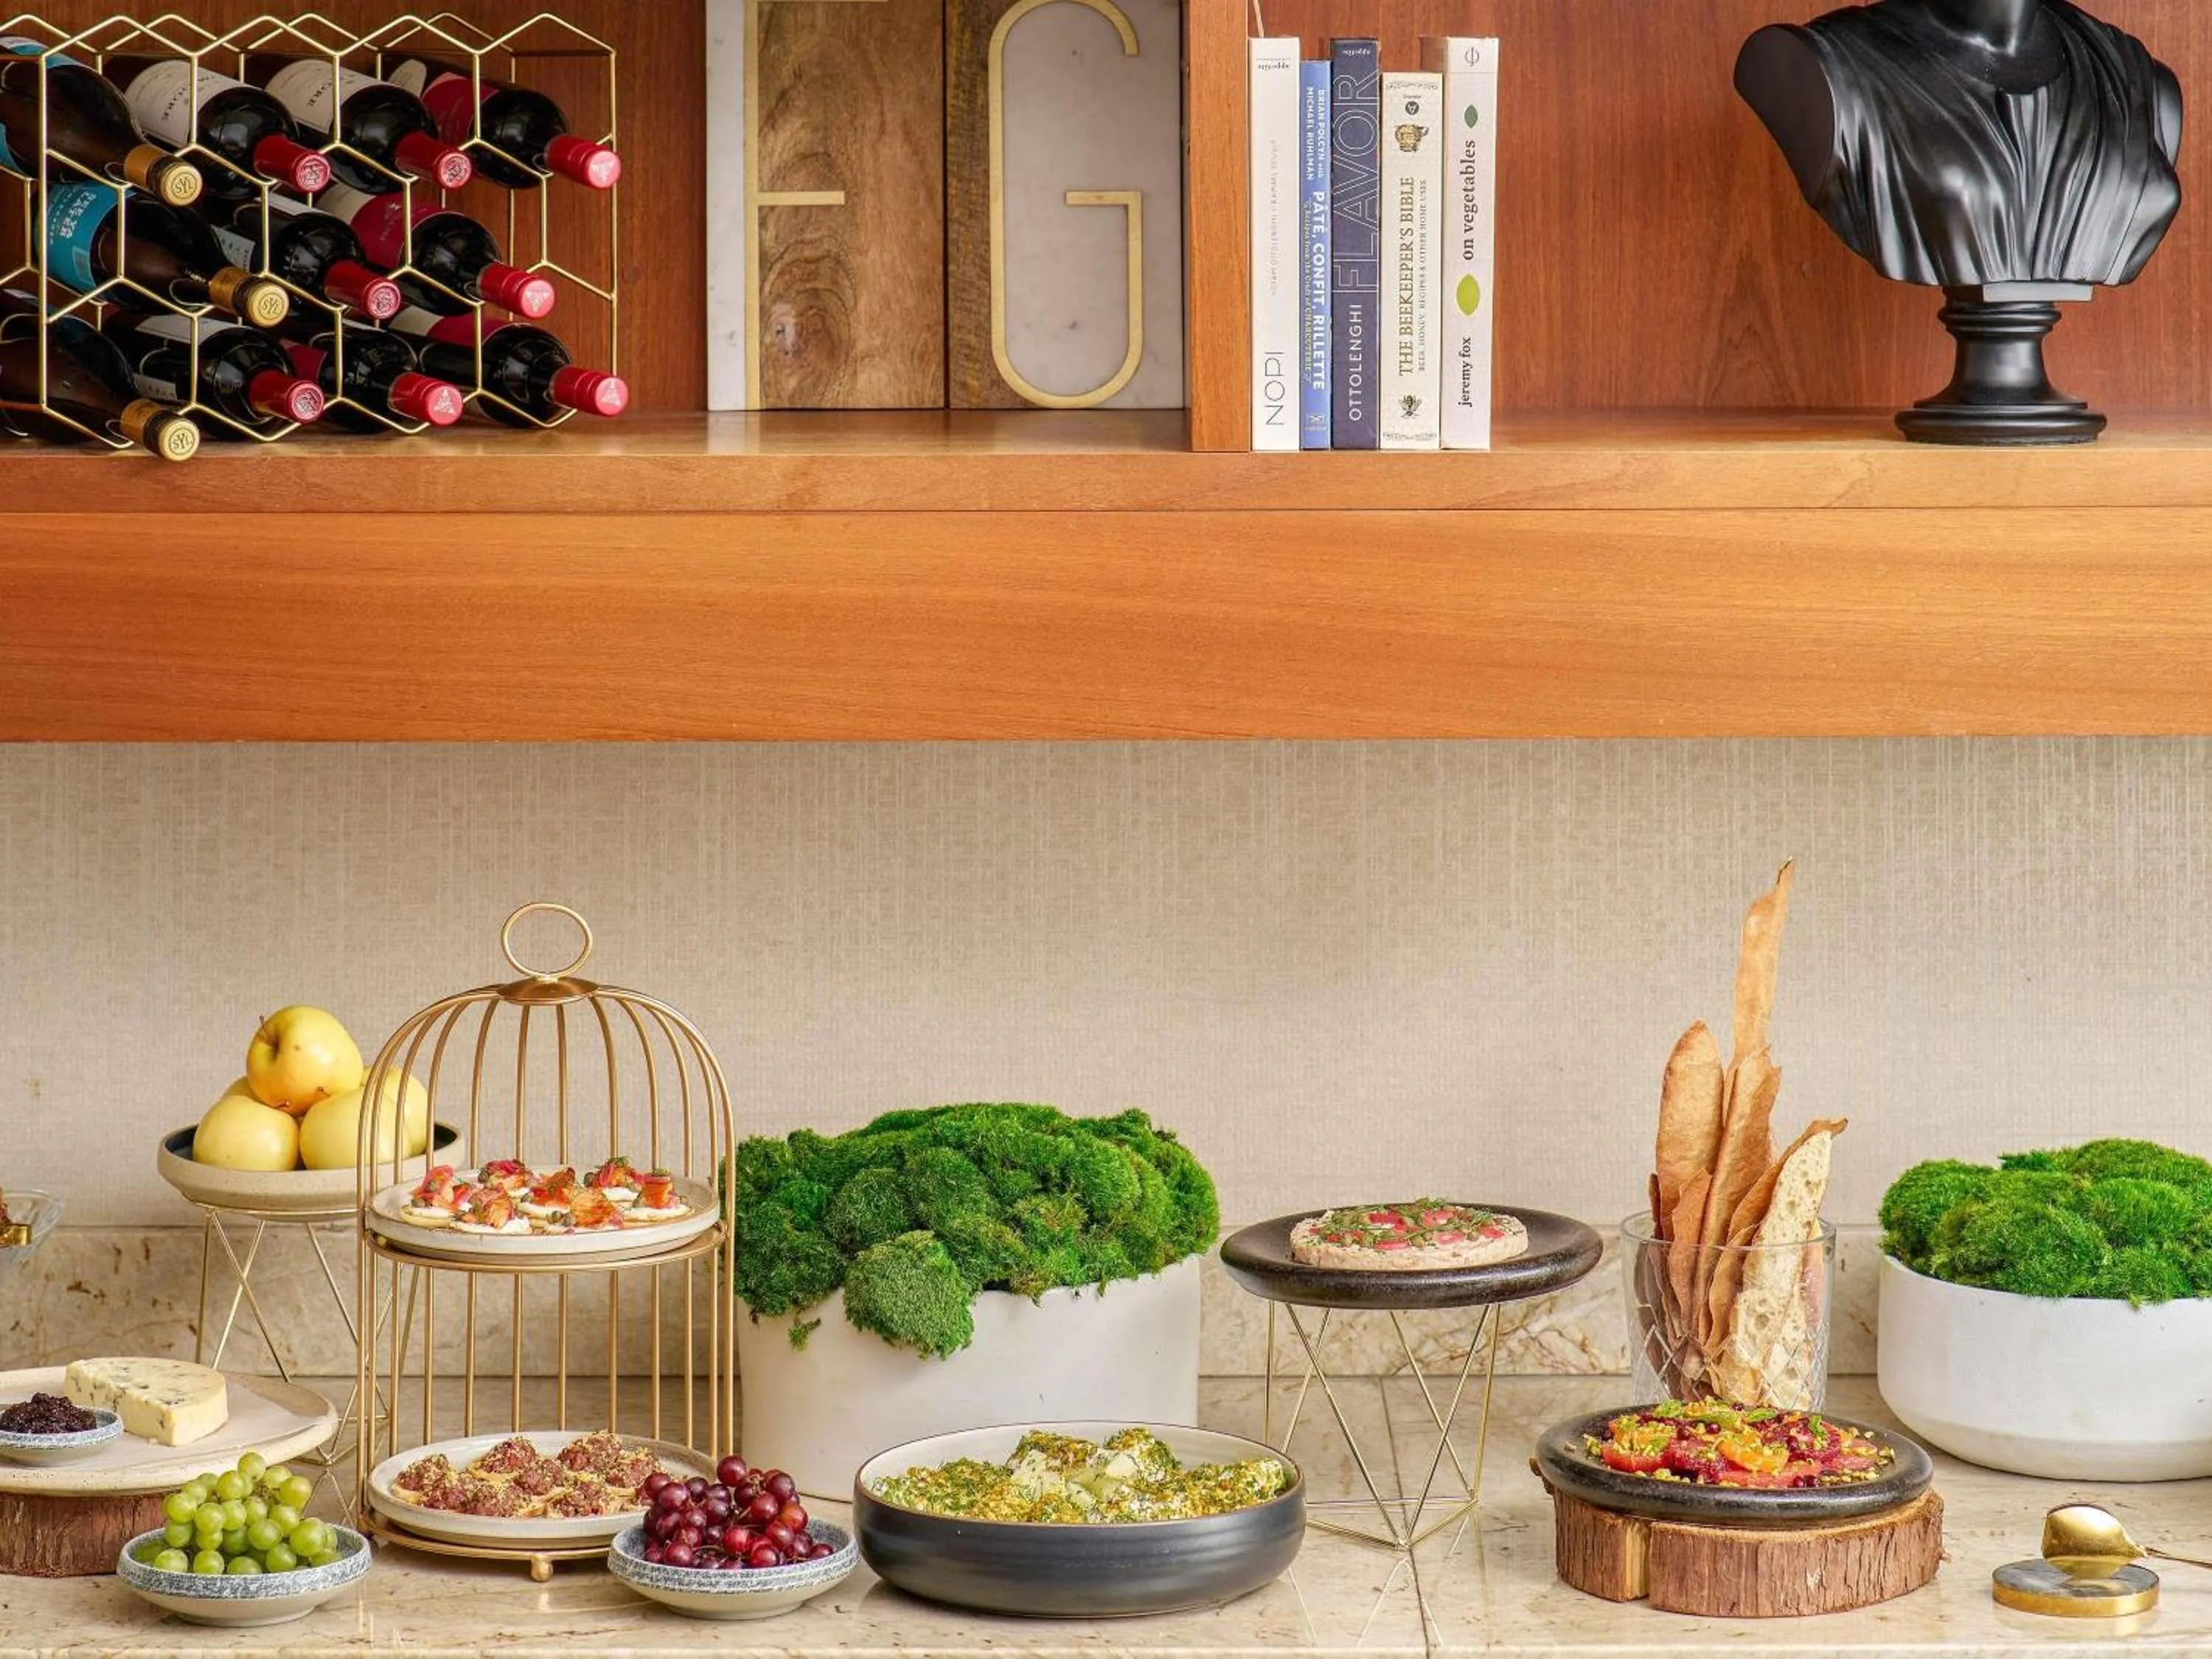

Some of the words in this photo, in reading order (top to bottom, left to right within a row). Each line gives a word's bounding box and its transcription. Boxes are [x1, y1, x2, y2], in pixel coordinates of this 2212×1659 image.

[1306, 86, 1315, 129] MICHAEL
[1306, 132, 1315, 181] RUHLMAN
[1318, 122, 1326, 160] POLCYN
[989, 0, 1144, 408] G
[1332, 70, 1379, 293] FLAVOR
[1399, 176, 1413, 223] BIBLE
[1459, 140, 1478, 234] vegetables
[1312, 191, 1328, 238] PÂTÉ,
[1462, 238, 1474, 260] on
[1312, 243, 1325, 310] CONFIT,
[1399, 227, 1413, 337] BEEKEEPER'S
[1312, 314, 1326, 390] RILLETTE
[1349, 304, 1363, 421] OTTOLENGHI
[1399, 341, 1413, 377] THE
[1458, 336, 1471, 358] fox
[1264, 352, 1284, 425] NOPI
[1458, 361, 1473, 408] jeremy
